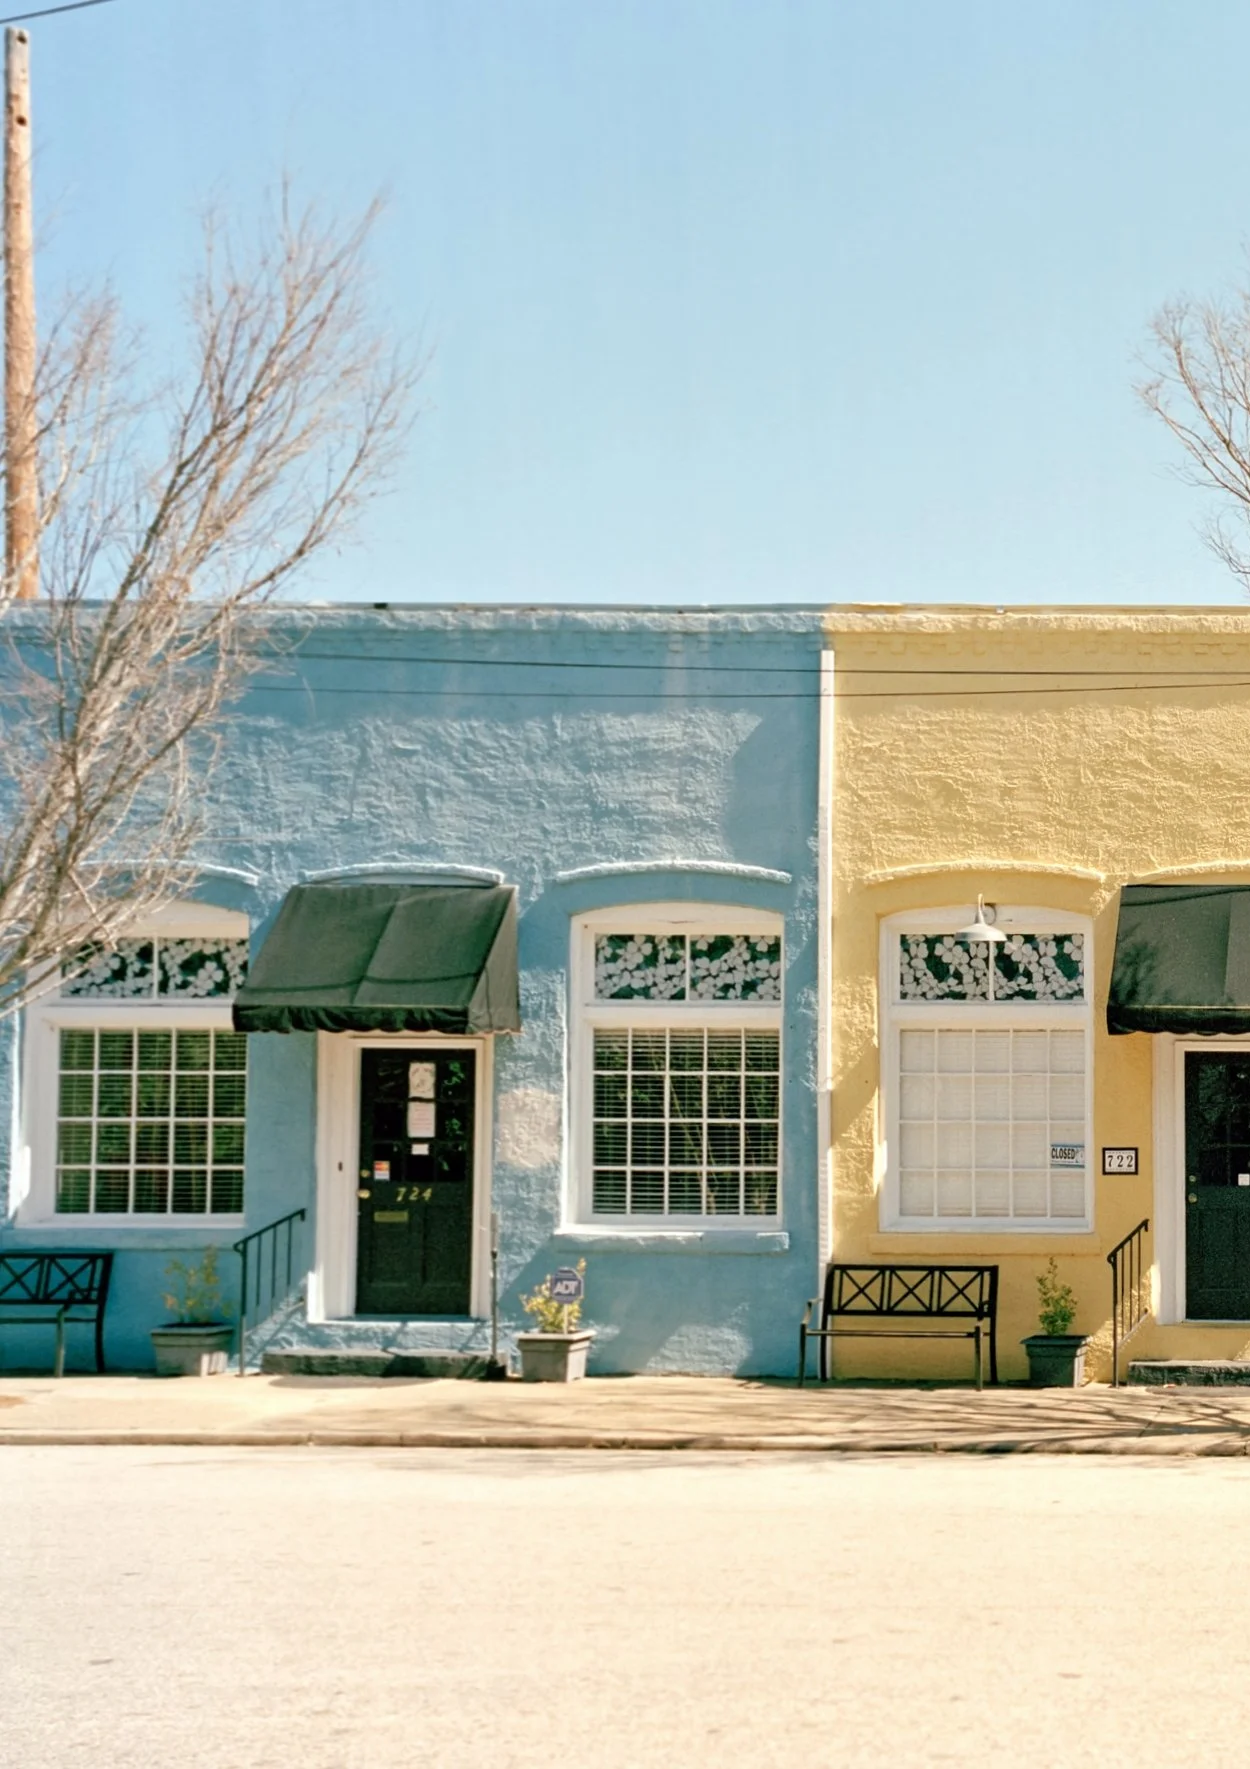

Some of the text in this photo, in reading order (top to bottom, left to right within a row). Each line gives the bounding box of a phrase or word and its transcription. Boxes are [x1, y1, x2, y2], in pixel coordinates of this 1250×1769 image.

[1051, 1147, 1076, 1160] CLOSED
[1107, 1154, 1134, 1168] 722
[396, 1187, 432, 1202] 724
[553, 1280, 578, 1295] ADT
